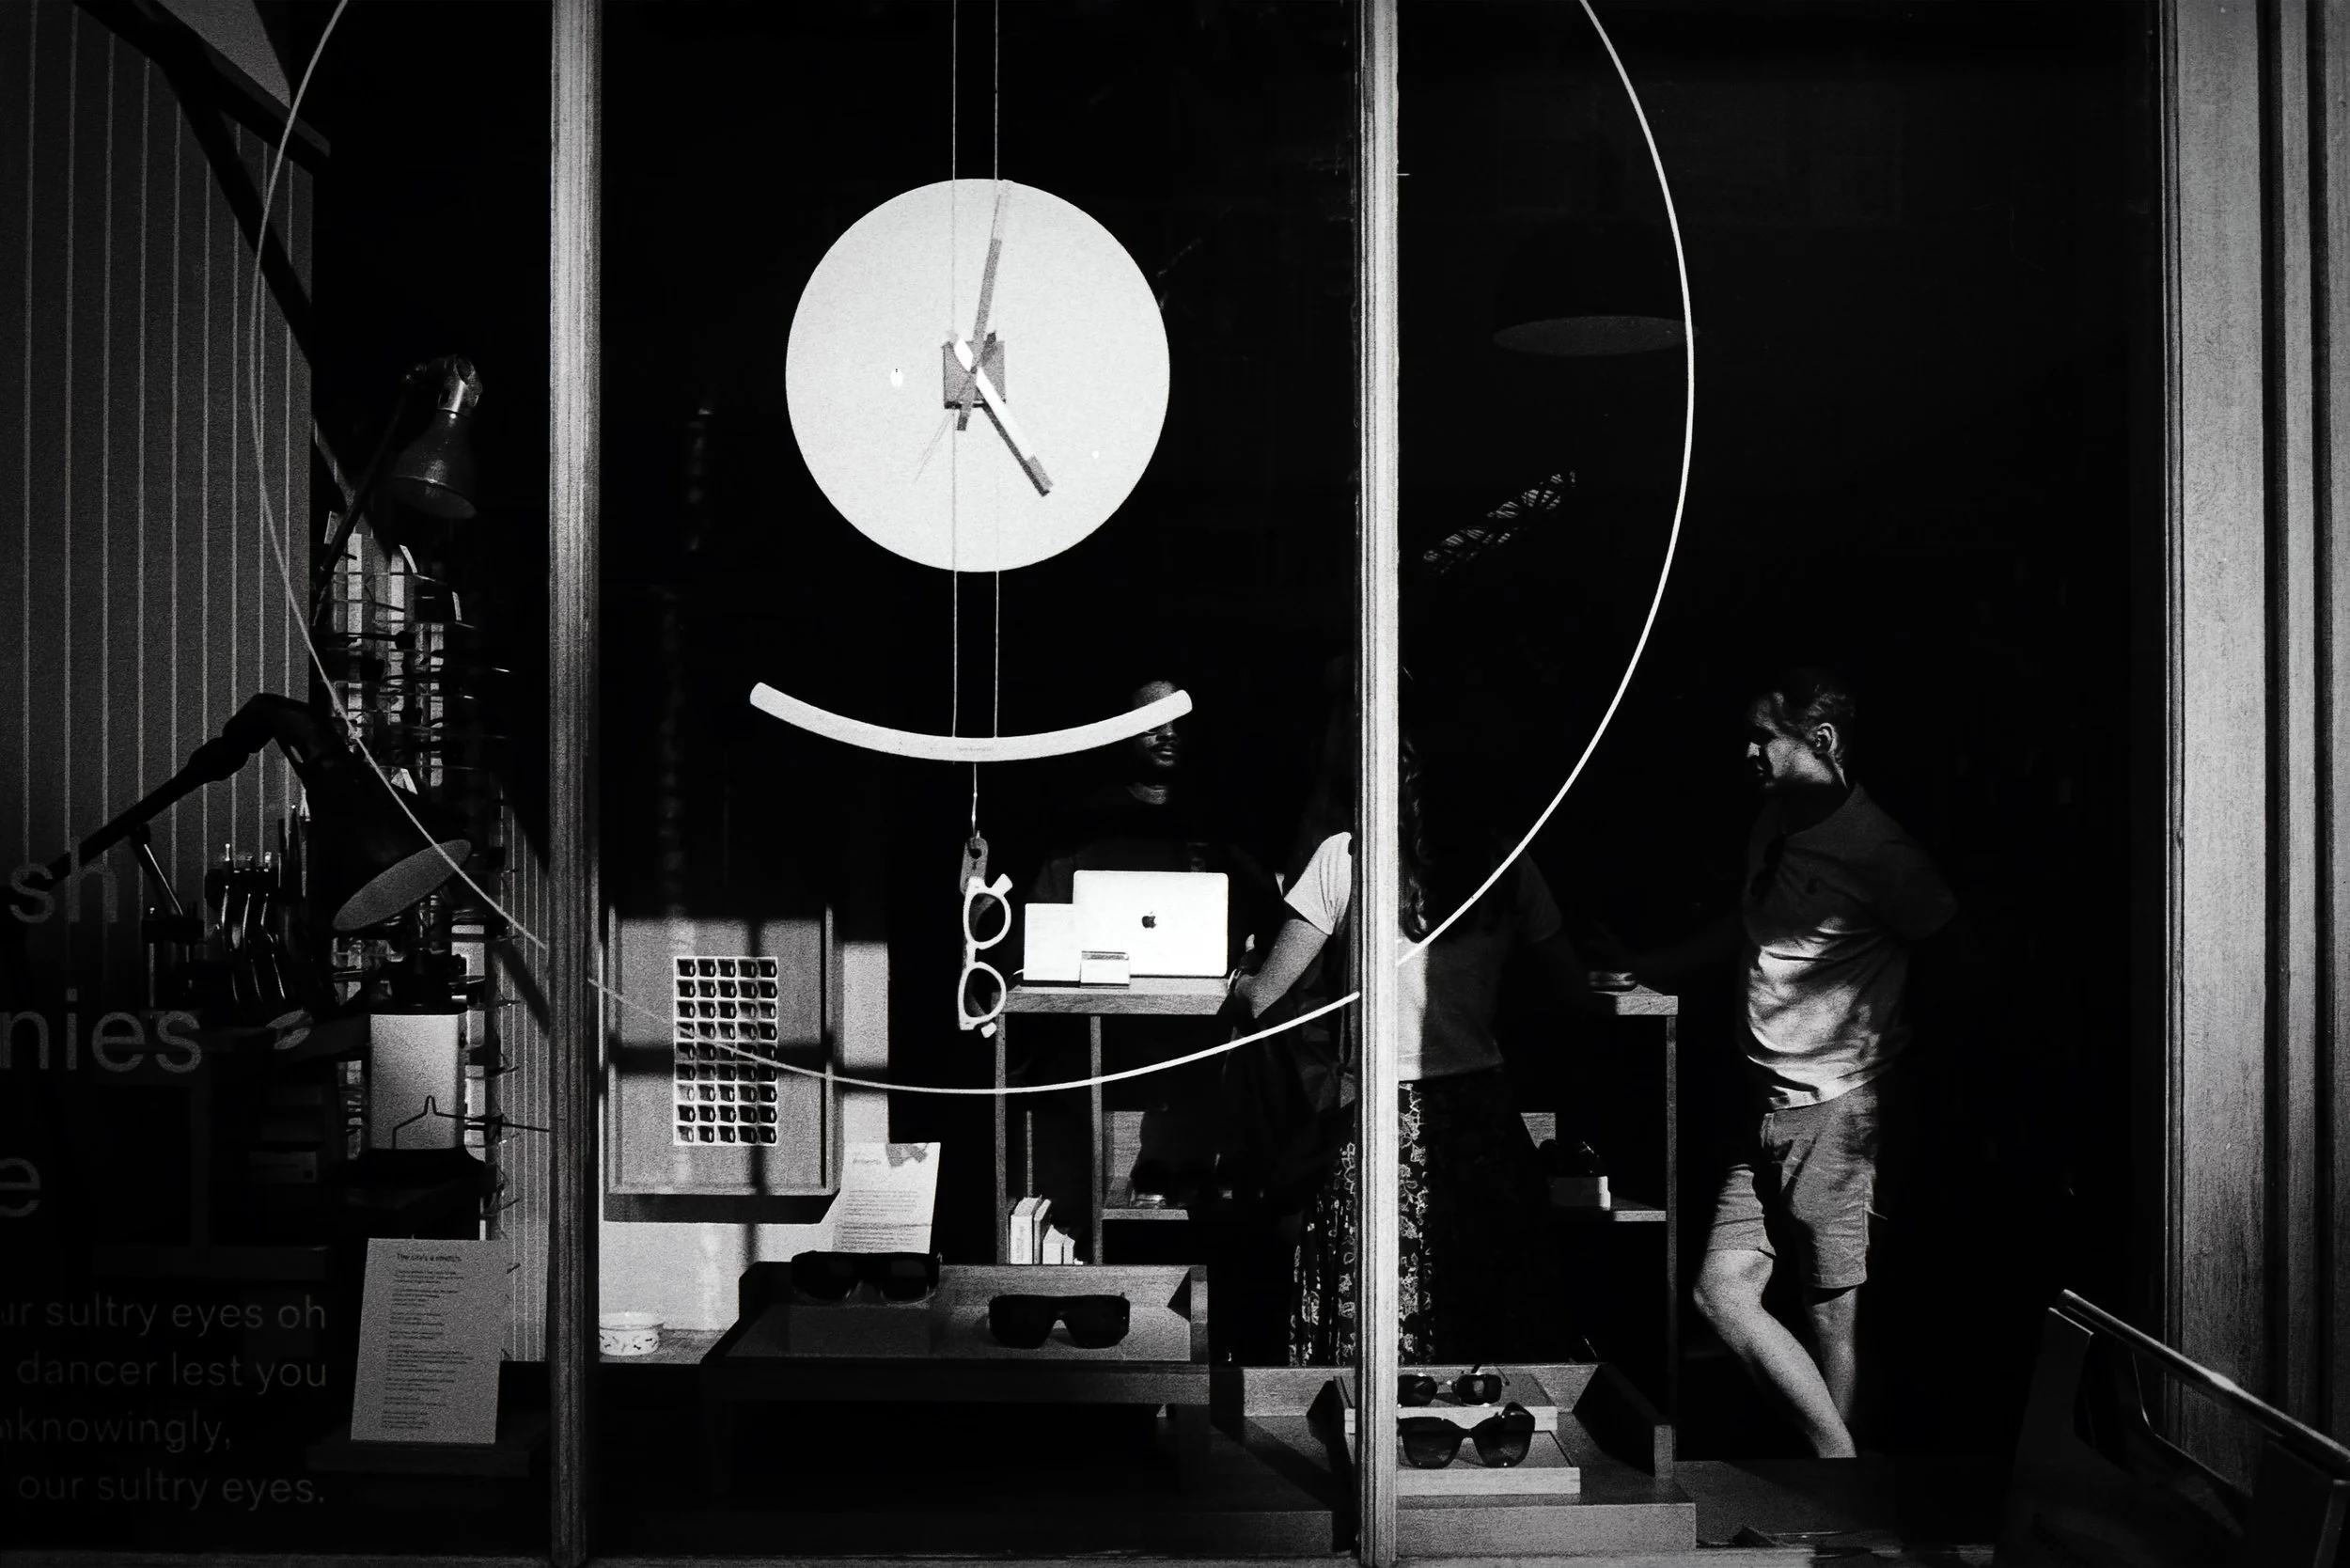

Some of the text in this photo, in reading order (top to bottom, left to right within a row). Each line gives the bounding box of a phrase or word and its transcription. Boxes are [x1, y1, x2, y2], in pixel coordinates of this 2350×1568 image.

[0, 988, 202, 1073] nies
[0, 1157, 41, 1218] e
[45, 1292, 158, 1337] sultry
[171, 1304, 264, 1338] eyes
[277, 1294, 325, 1328] oh
[16, 1348, 327, 1397] dancer lest you
[18, 1466, 325, 1512] our sultry eyes.
